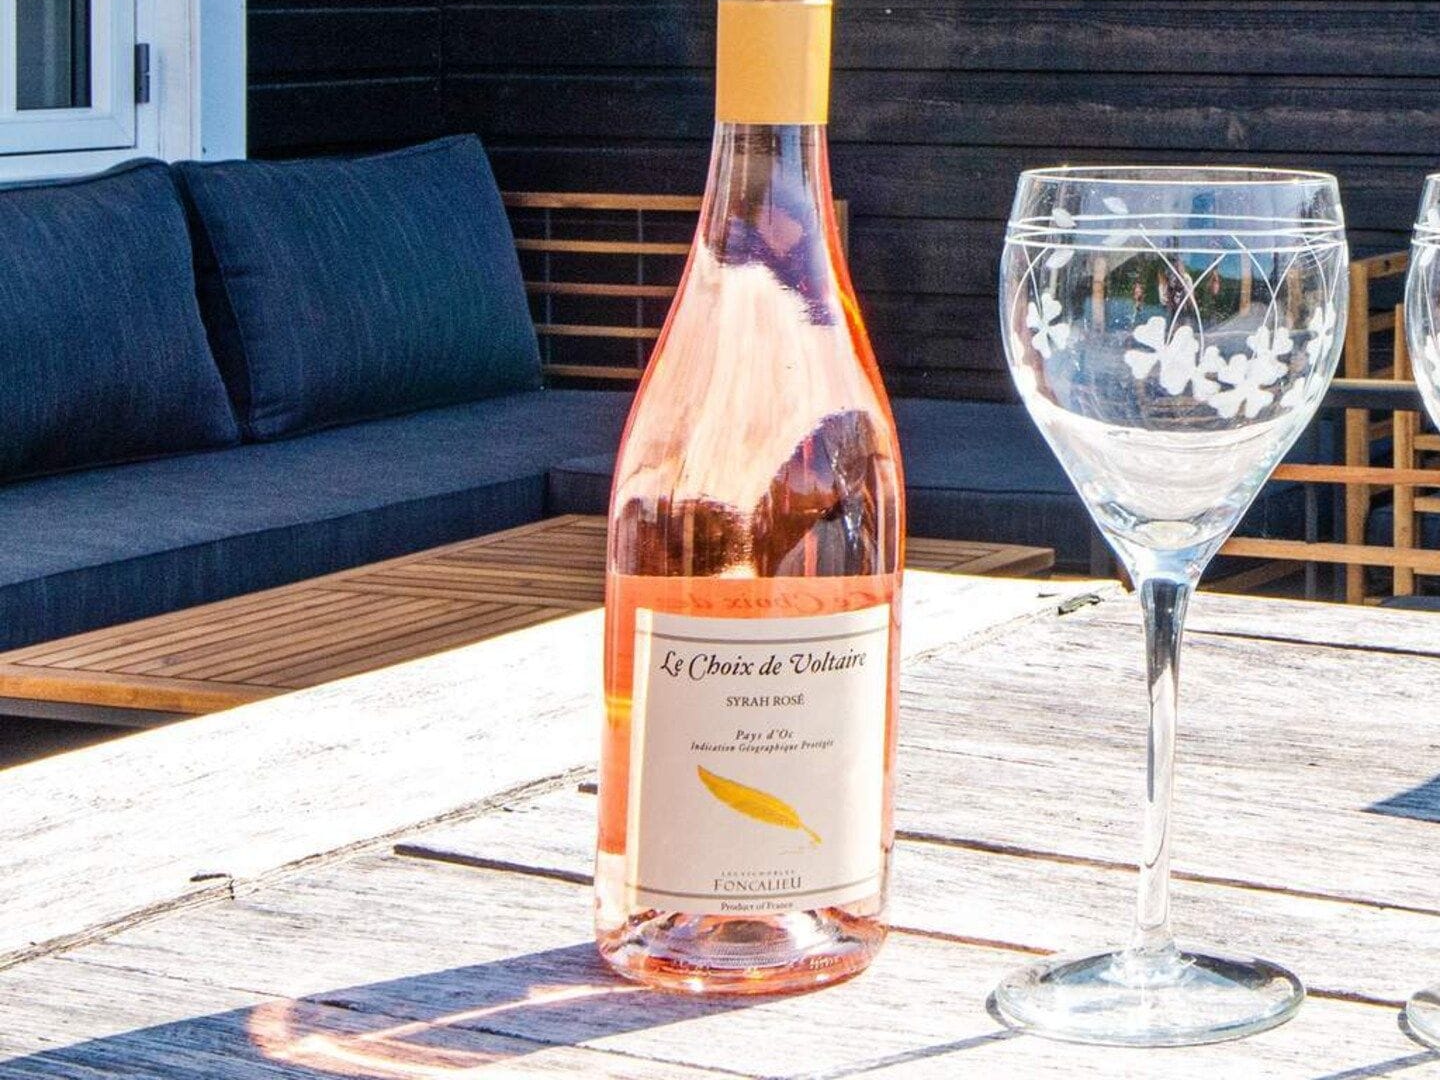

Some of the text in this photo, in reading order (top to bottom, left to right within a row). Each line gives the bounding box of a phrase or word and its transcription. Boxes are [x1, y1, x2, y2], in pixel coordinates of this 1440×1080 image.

[661, 648, 868, 681] Le Choix de Voltaire
[726, 693, 805, 707] SYRAH ROSÉ
[735, 729, 762, 743] Pays
[690, 742, 736, 752] Indication
